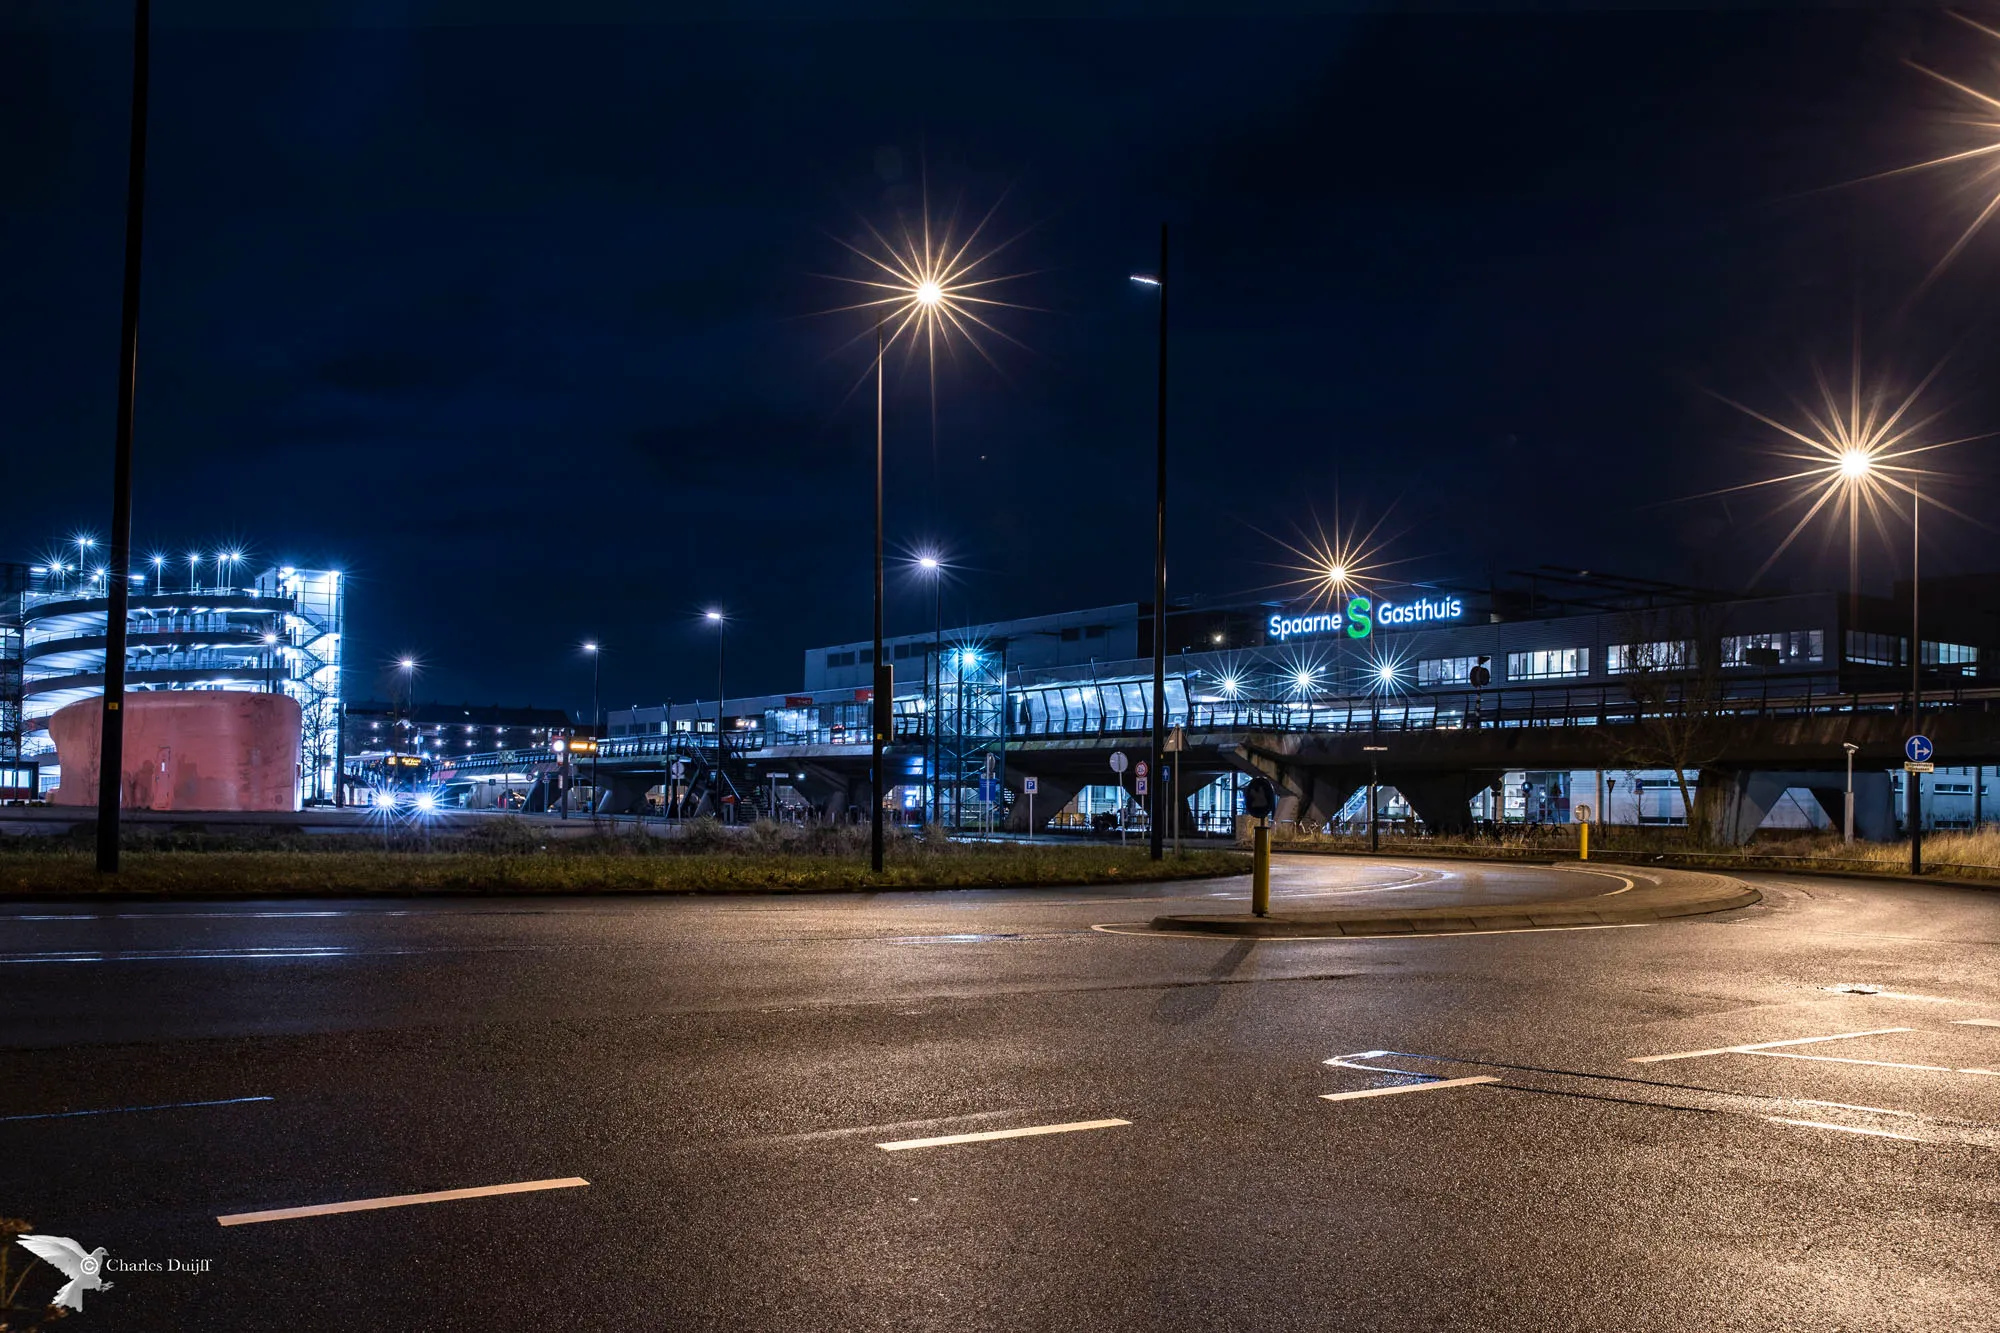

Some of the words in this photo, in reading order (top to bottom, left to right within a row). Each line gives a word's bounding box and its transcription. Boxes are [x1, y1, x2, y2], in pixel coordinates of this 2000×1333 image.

[1270, 613, 1342, 640] Spaarne
[1347, 597, 1371, 639] S
[1378, 596, 1461, 625] Gasthuis
